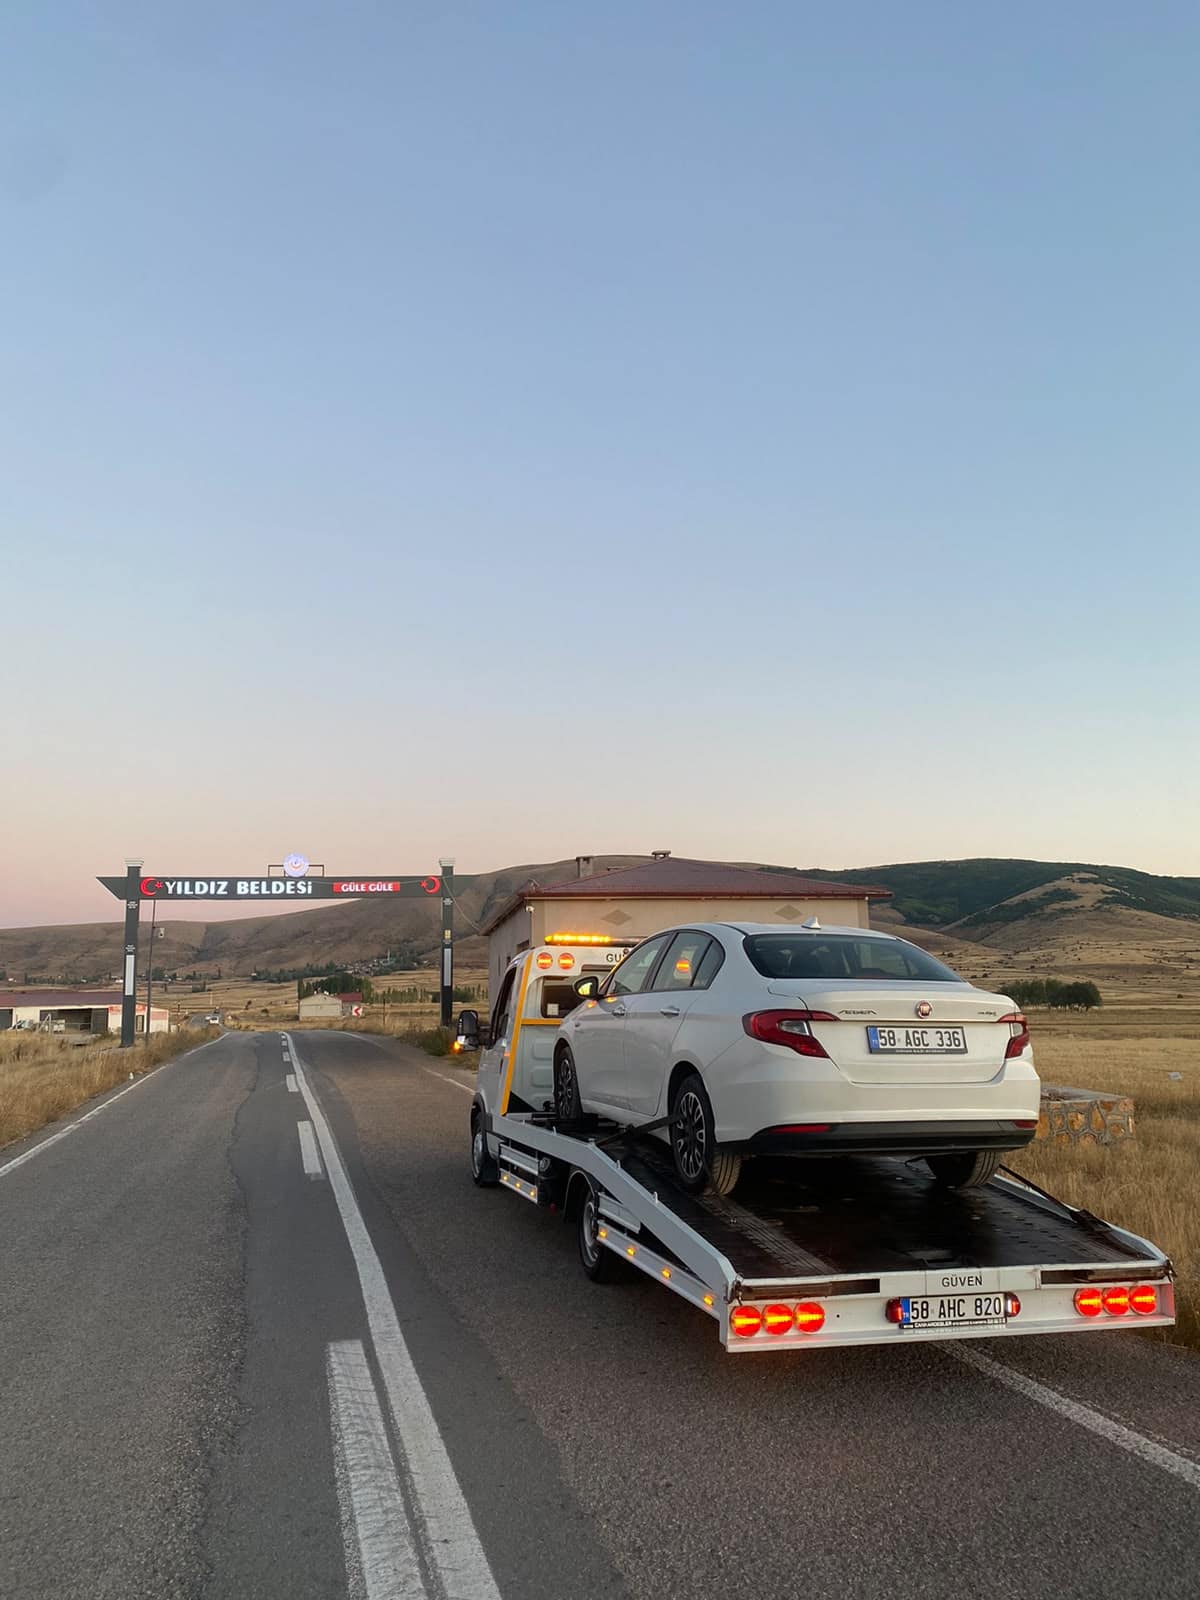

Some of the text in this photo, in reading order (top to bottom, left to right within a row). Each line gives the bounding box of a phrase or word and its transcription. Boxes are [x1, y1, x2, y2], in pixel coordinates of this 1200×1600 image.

[165, 881, 228, 895] YILDIZ
[341, 881, 393, 892] GÜLE GÜLE
[879, 1030, 961, 1047] 58 AGC 336
[941, 1274, 983, 1287] GÜVEN
[911, 1296, 1002, 1319] 58 AHC 820
